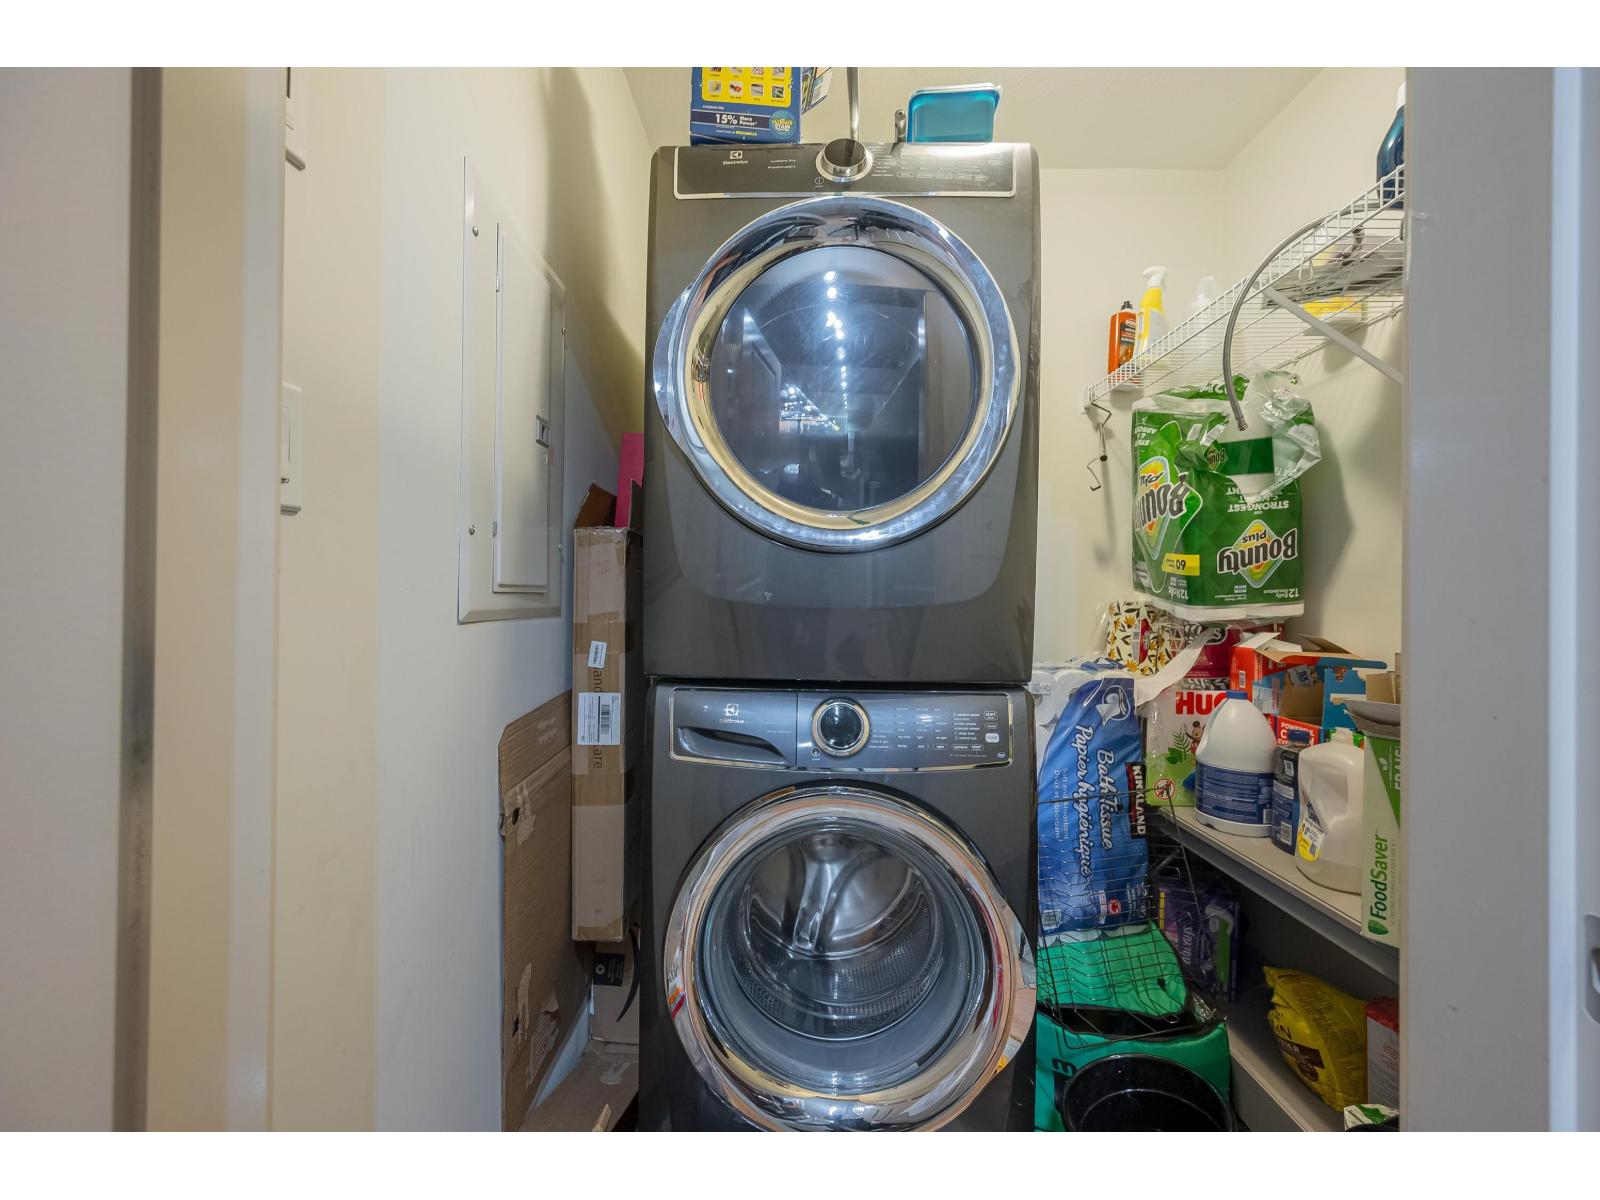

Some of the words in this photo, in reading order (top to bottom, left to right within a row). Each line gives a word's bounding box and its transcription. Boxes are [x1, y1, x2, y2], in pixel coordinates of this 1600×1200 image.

[715, 113, 738, 125] 15%
[1137, 471, 1165, 486] plu
[1227, 500, 1290, 514] STRONGEST
[1216, 527, 1298, 575] Bounty
[1242, 529, 1267, 544] plus
[1175, 559, 1186, 571] 60
[1180, 589, 1189, 600] 12
[1288, 587, 1300, 598] 12
[1070, 724, 1094, 780] Papier
[1096, 748, 1115, 793] Bath
[1133, 765, 1146, 835] KIRKLAND
[1071, 781, 1096, 878] hygiénique
[1098, 794, 1119, 850] Tissue
[1369, 833, 1389, 921] FoodSaver
[1182, 925, 1196, 965] always
